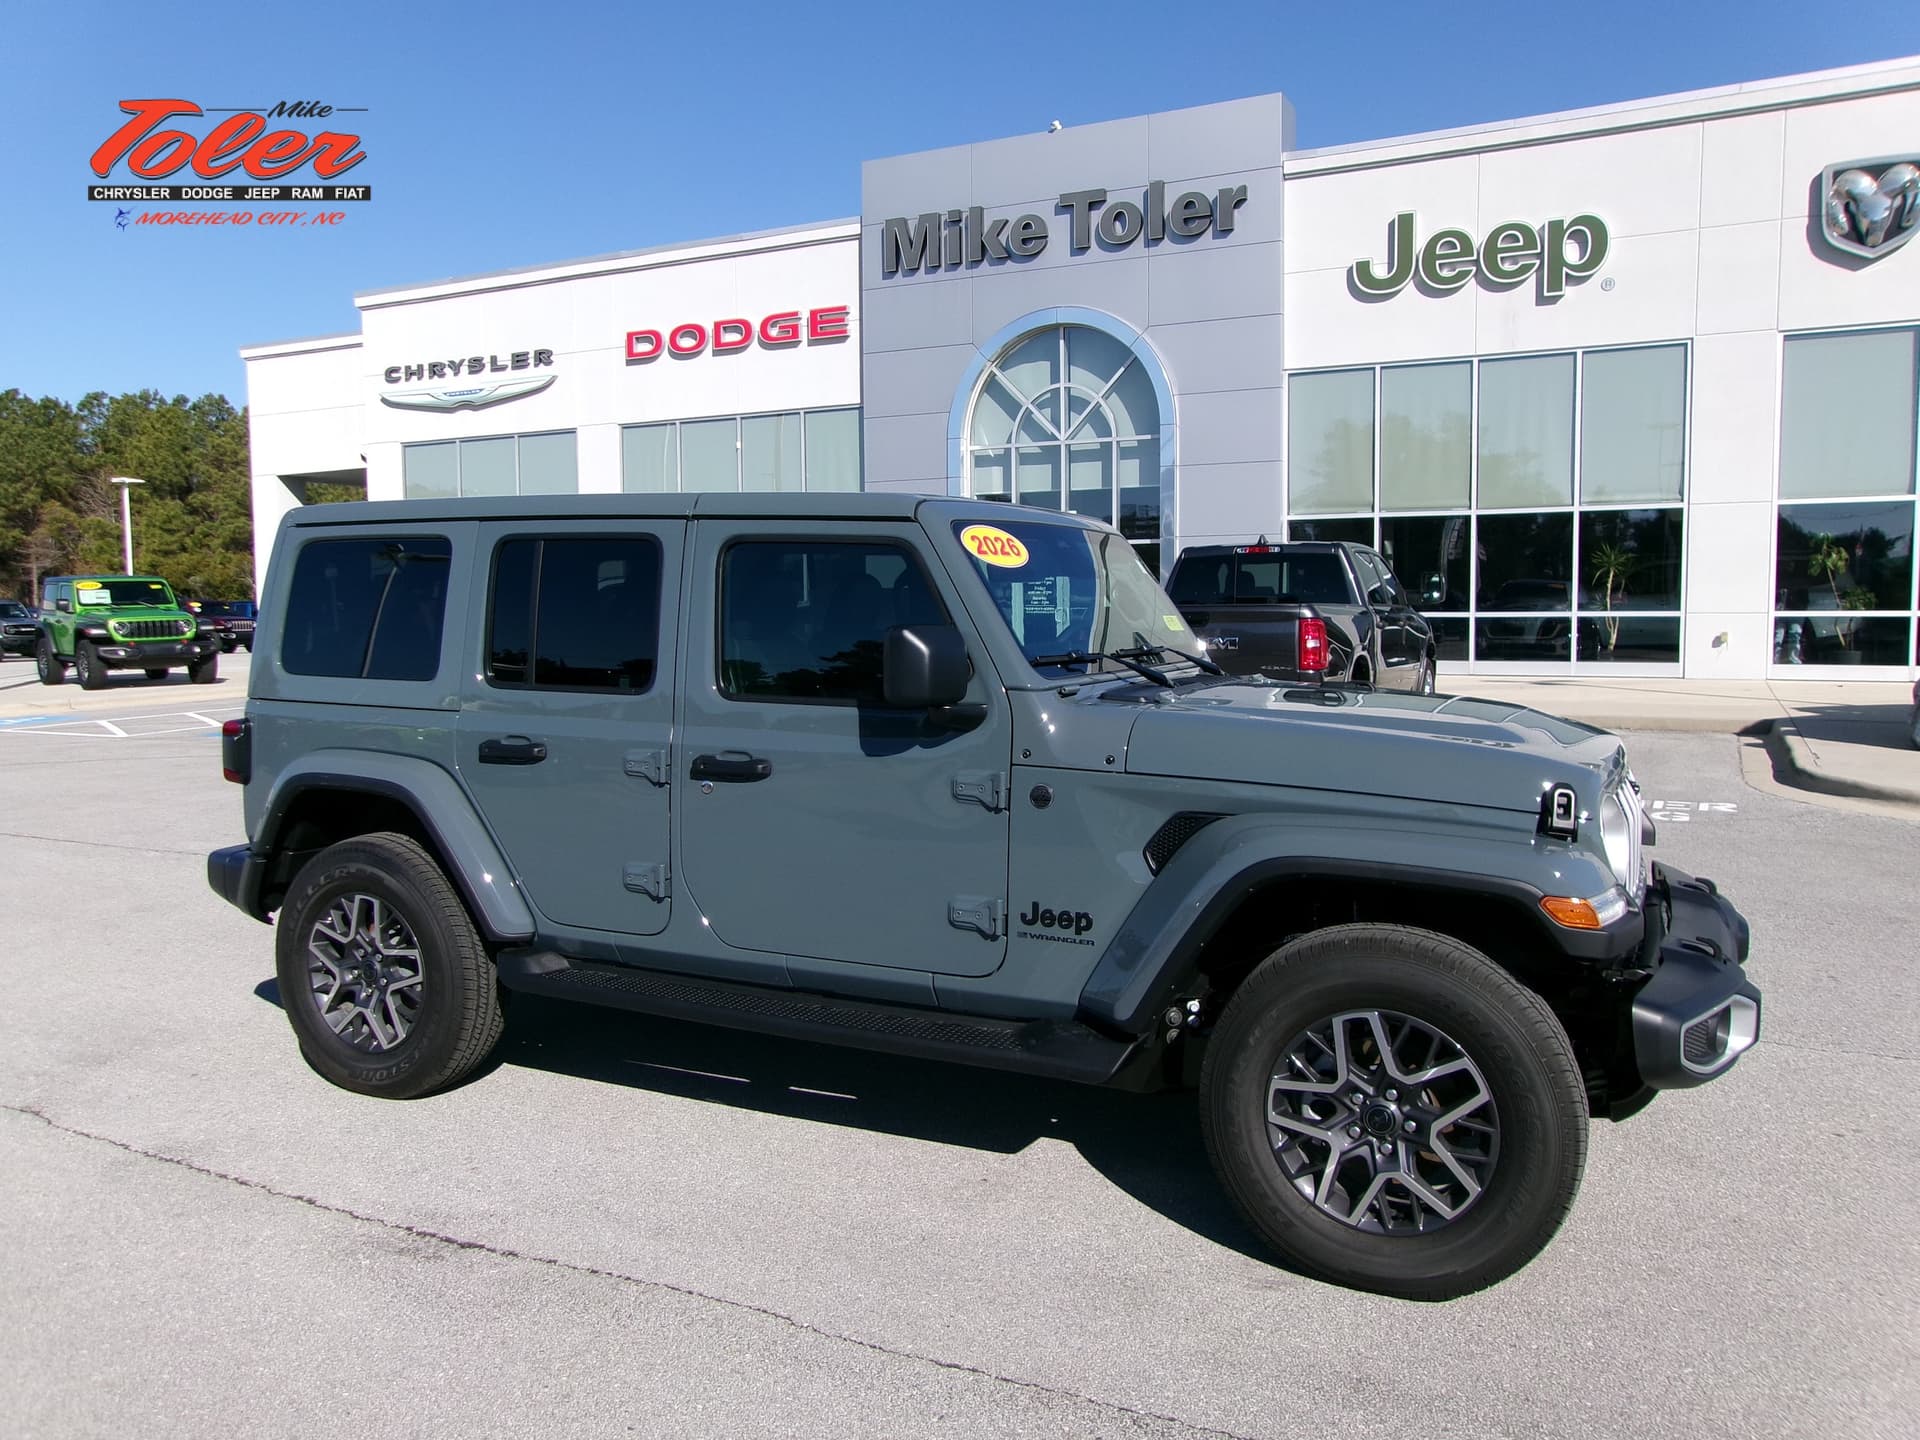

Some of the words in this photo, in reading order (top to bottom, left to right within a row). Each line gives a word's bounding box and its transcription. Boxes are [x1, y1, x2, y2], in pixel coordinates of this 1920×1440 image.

[883, 206, 1050, 274] Mike
[1057, 180, 1249, 251] Toler
[1350, 210, 1610, 302] Jeep
[625, 305, 851, 364] DODGE
[384, 348, 554, 383] CHRYSLER
[970, 535, 1021, 557] 2026
[1020, 901, 1094, 935] Jeep
[1028, 932, 1095, 946] WRANGLER
